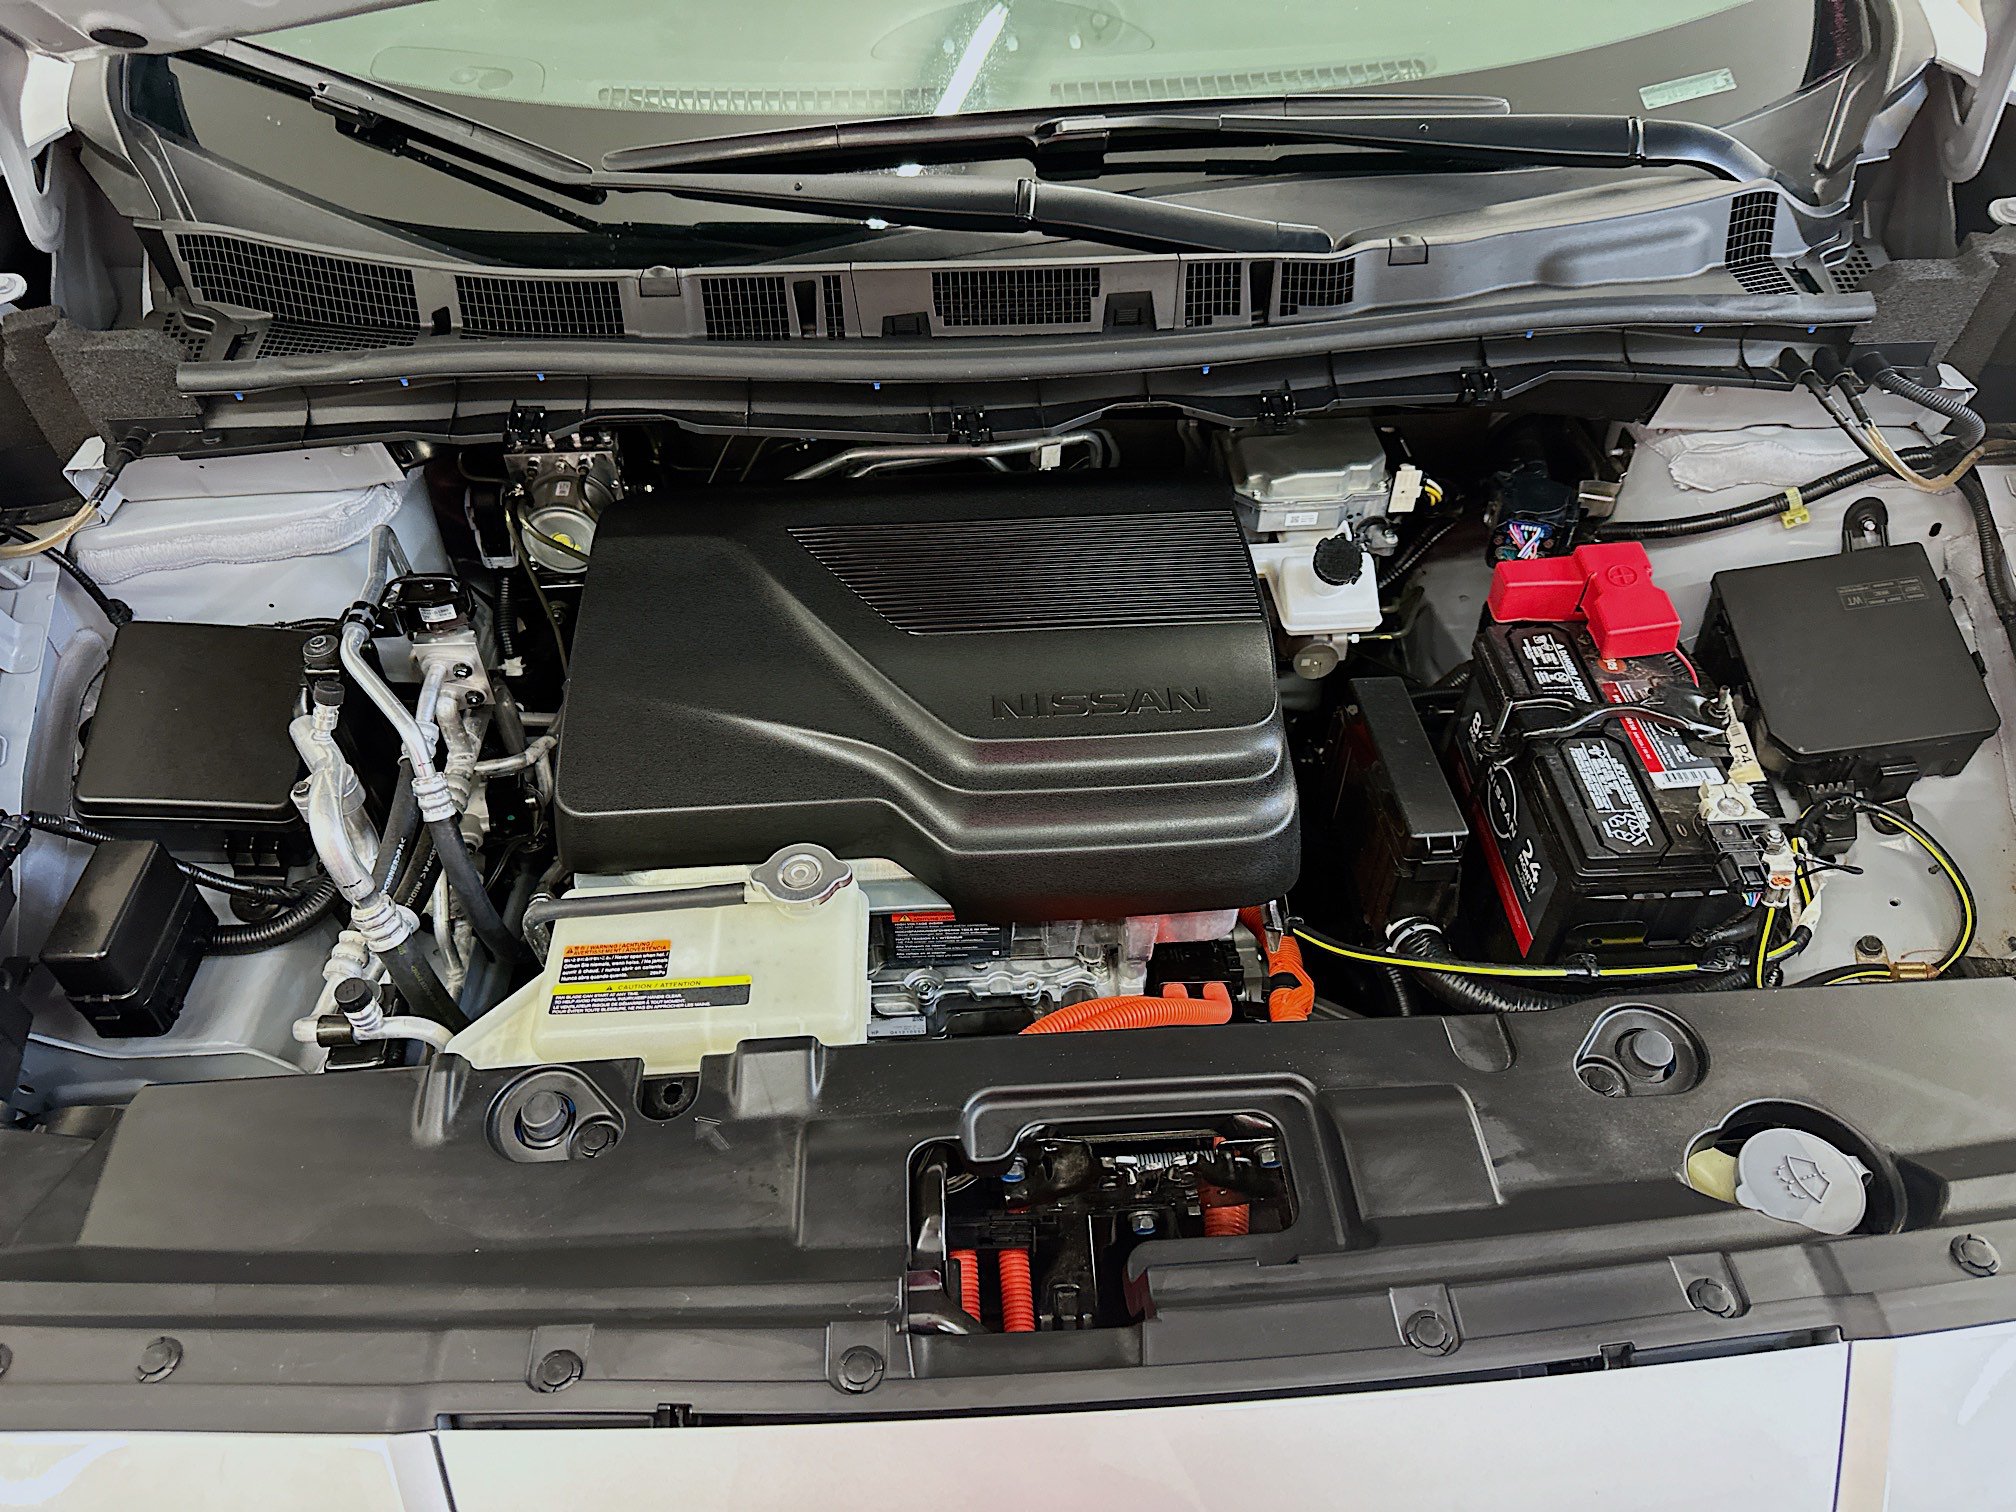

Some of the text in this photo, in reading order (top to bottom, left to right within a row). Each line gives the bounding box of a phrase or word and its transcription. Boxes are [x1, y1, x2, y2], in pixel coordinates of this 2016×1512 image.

[992, 686, 1211, 720] NISSAN
[1734, 744, 1752, 763] P4
[1487, 766, 1518, 839] NISSAN
[1518, 853, 1536, 894] MONTH
[1522, 839, 1541, 883] 24
